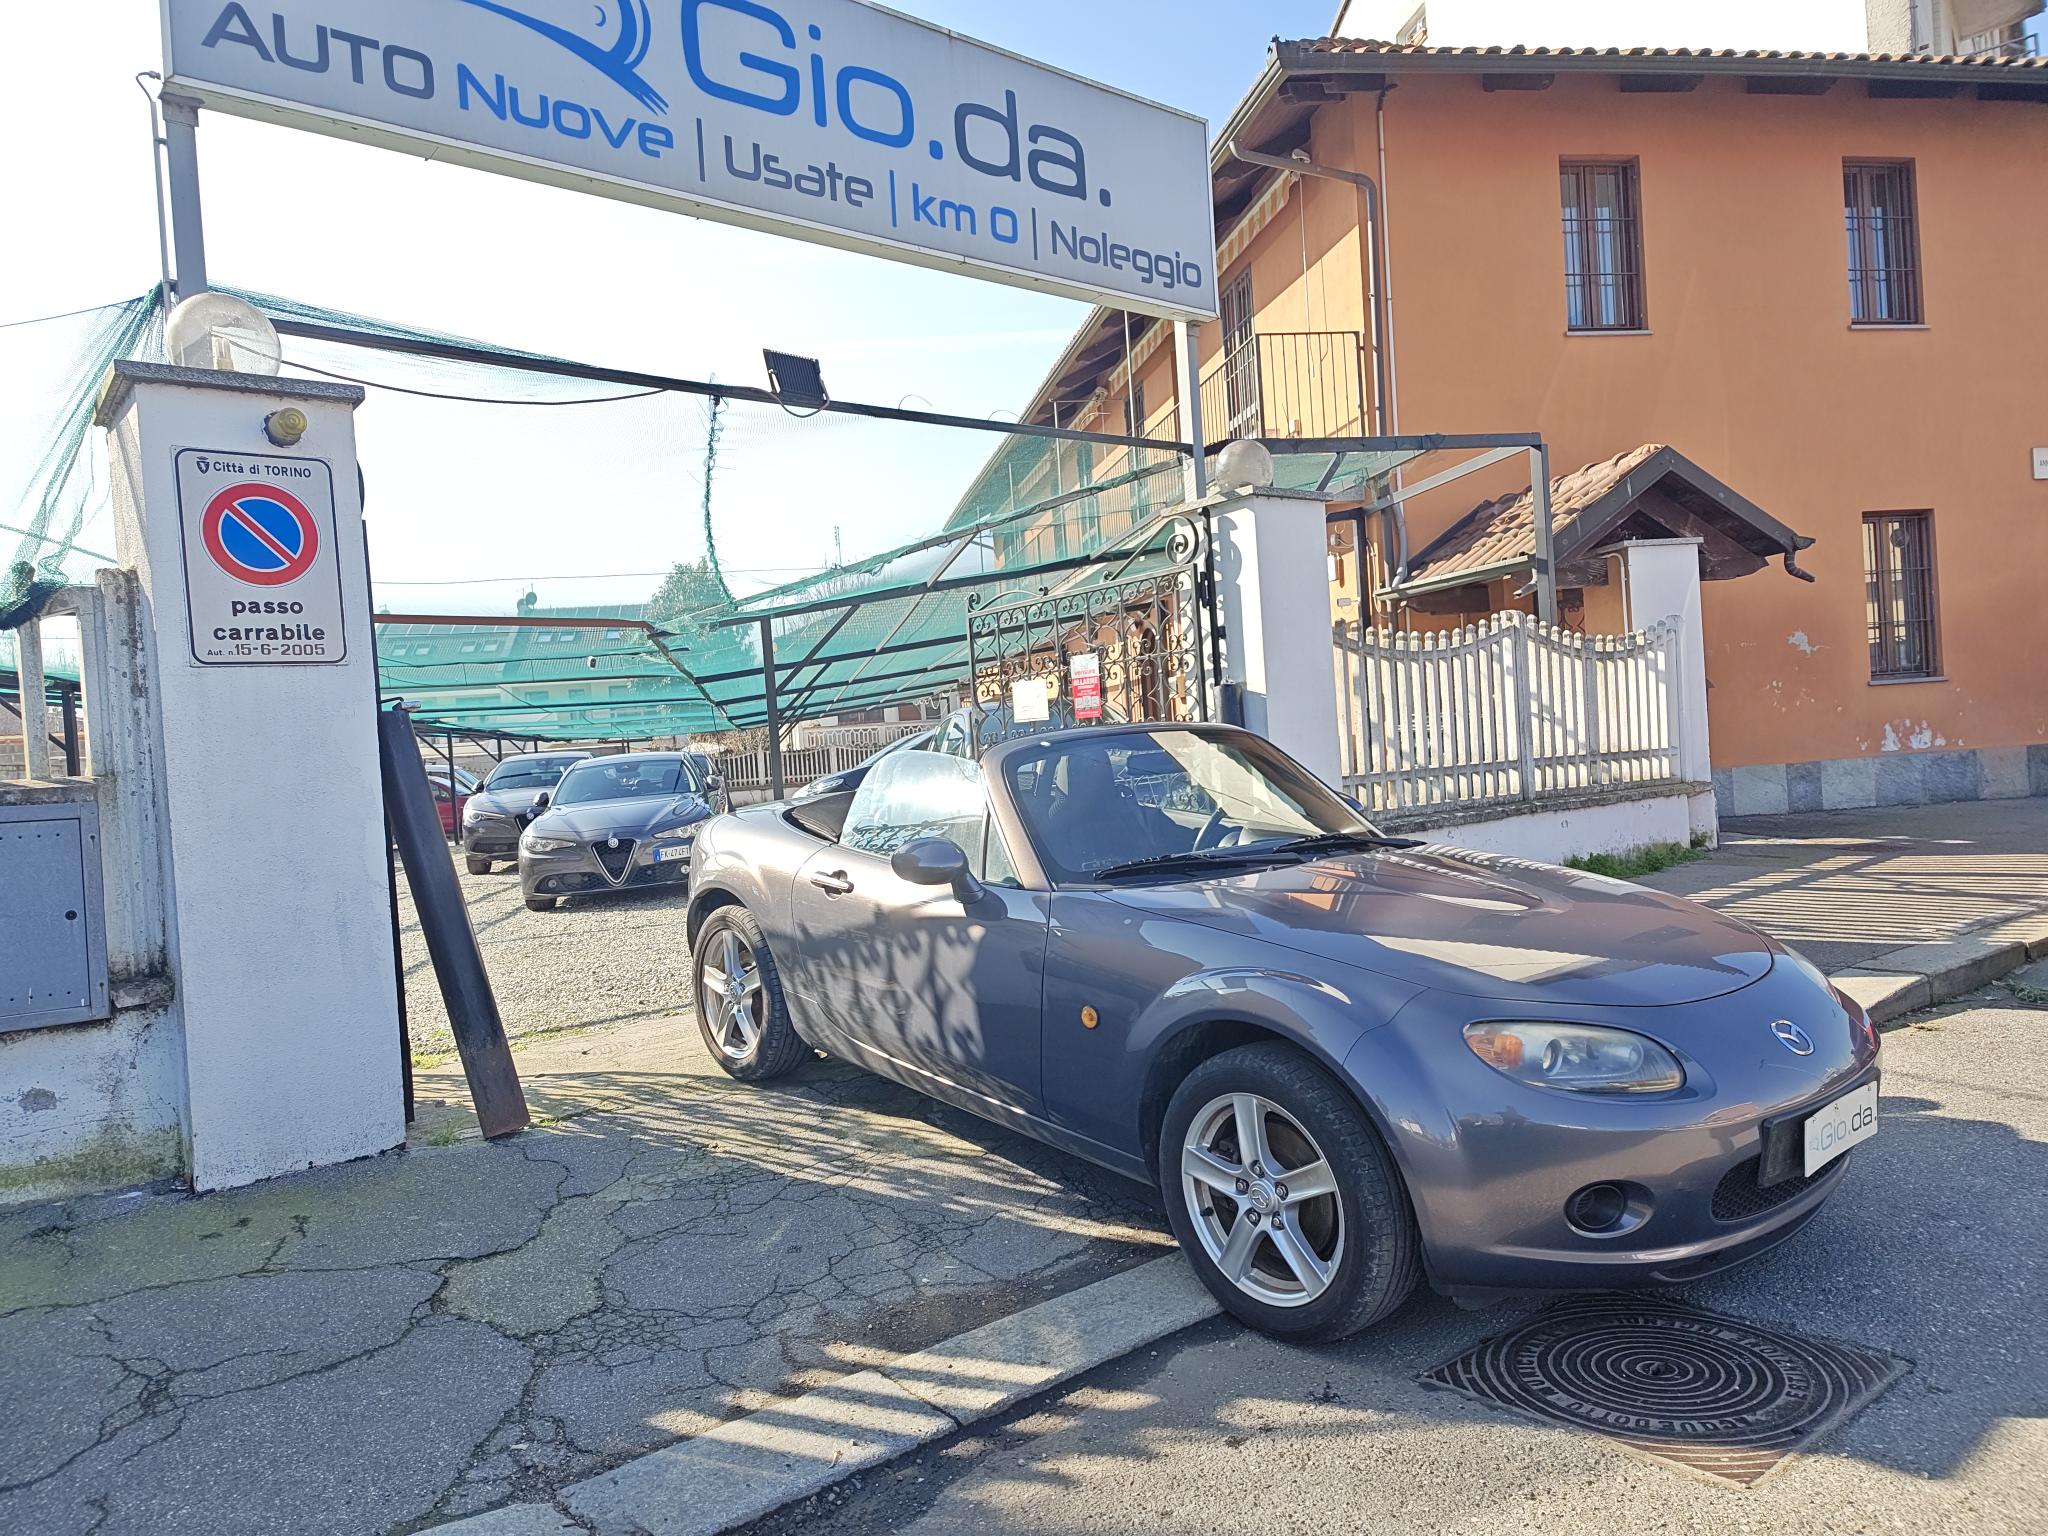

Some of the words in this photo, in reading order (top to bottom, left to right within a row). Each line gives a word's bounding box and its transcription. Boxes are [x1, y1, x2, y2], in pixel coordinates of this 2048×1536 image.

[201, 1, 435, 100] AUTO
[723, 134, 874, 208] Usate
[911, 182, 977, 236] km
[1050, 220, 1202, 289] Noleggio
[213, 461, 244, 474] Città
[249, 464, 260, 475] di
[264, 465, 312, 479] TORINO
[231, 600, 304, 617] passo
[213, 623, 325, 641] carrabile
[207, 649, 226, 657] Aut.
[234, 643, 325, 657] 15-6-2005
